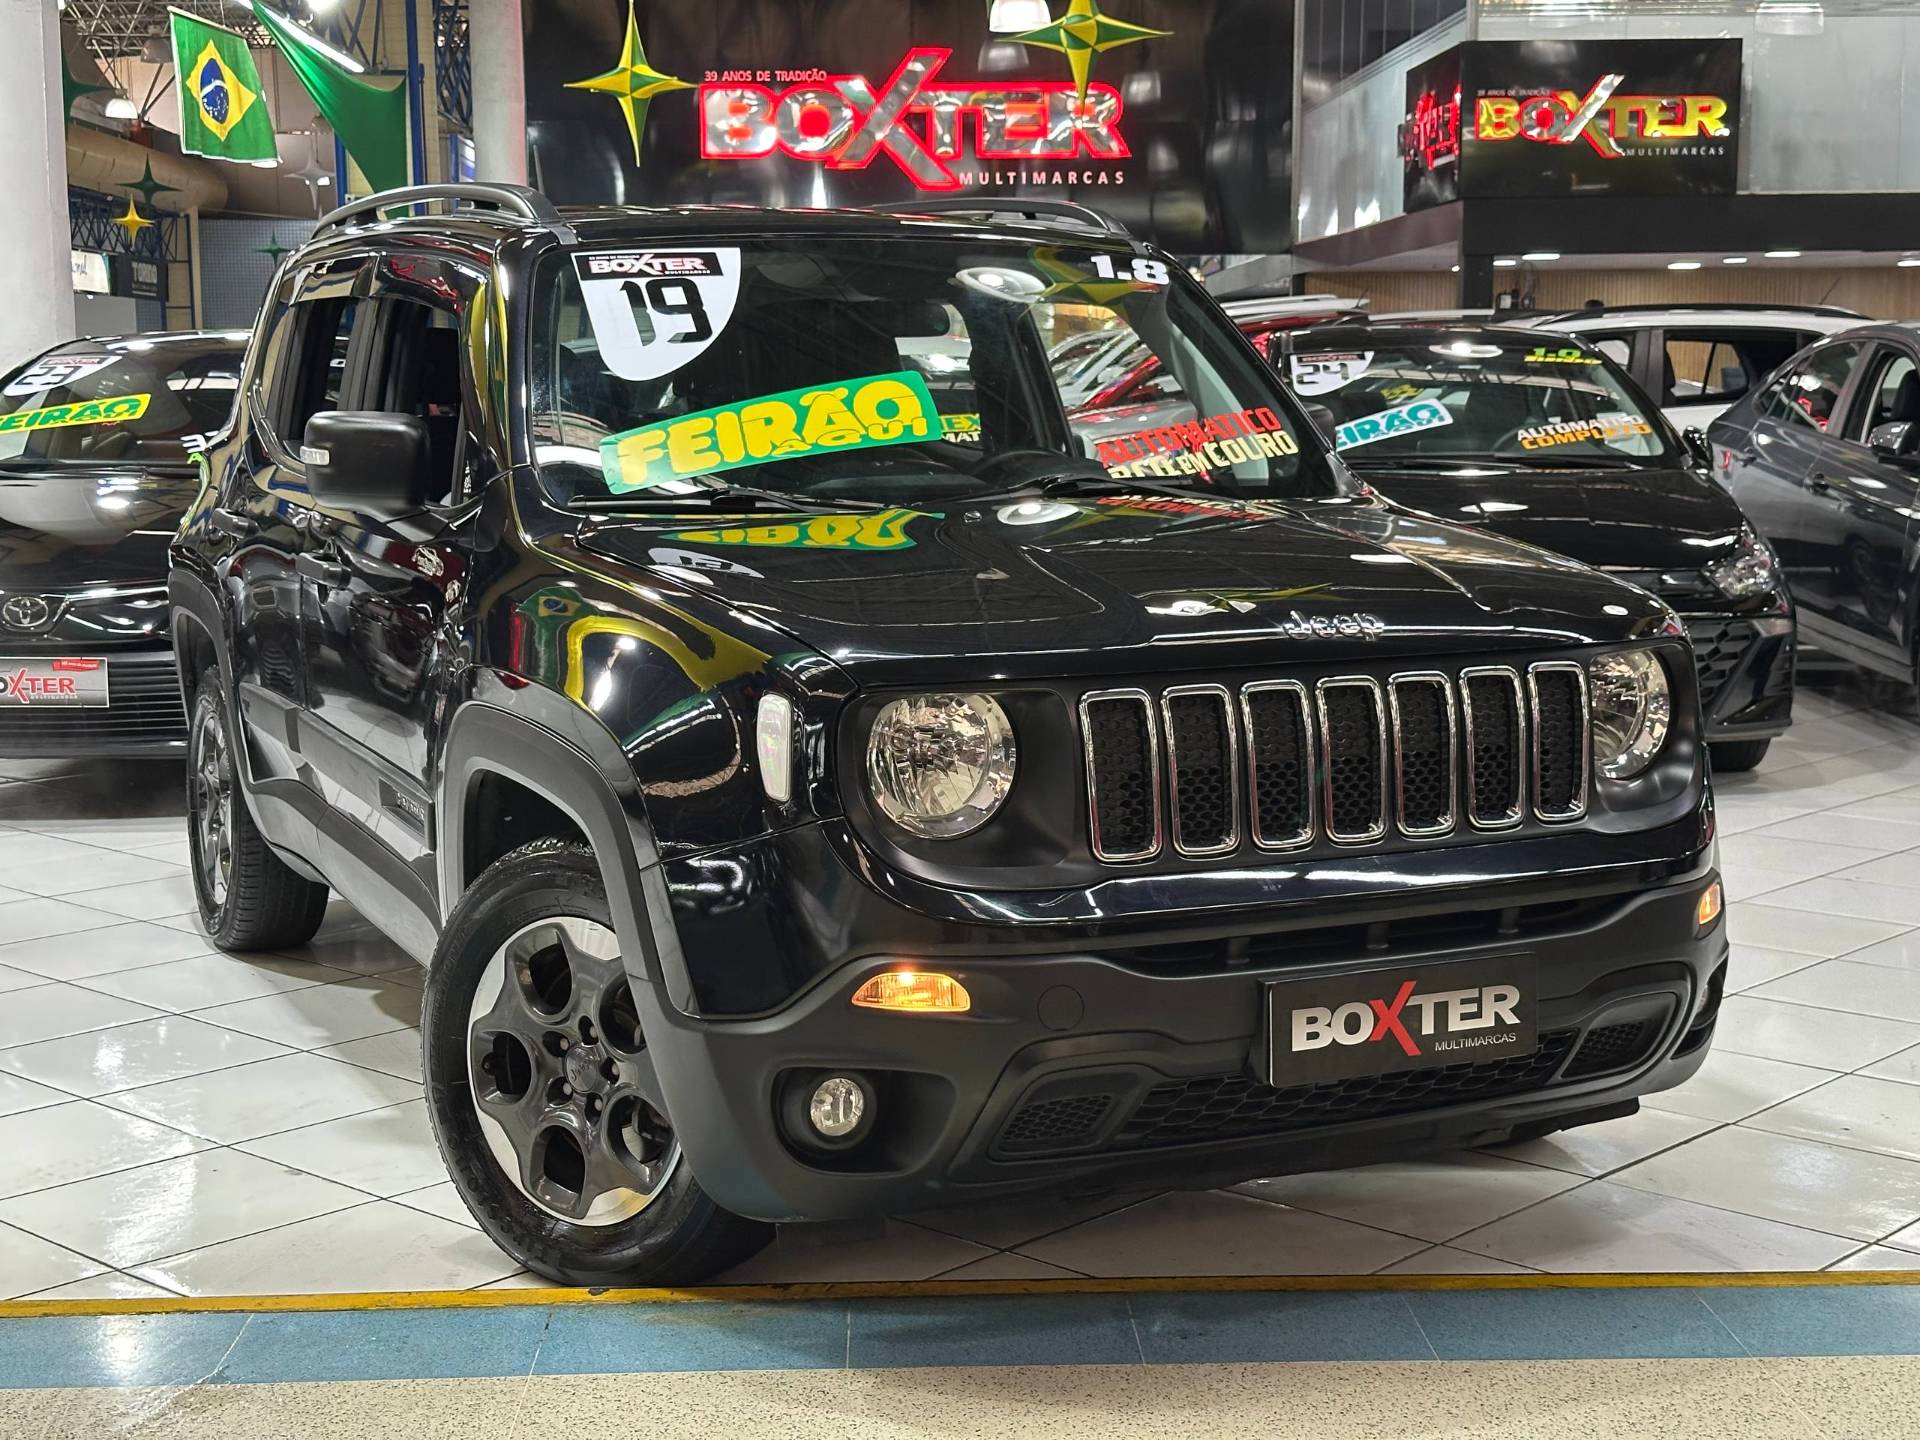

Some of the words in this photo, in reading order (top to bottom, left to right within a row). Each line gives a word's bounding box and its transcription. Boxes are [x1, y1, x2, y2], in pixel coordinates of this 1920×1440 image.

[704, 70, 718, 81] 39
[722, 70, 752, 81] ANOS
[756, 70, 771, 81] DE
[775, 68, 827, 83] TRADIÇÃO
[700, 48, 1132, 191] BOXTER
[1474, 73, 1730, 159] BOXTER
[1626, 146, 1724, 156] MULTIMARCAS
[960, 171, 1124, 185] MULTIMARCAS
[589, 253, 708, 275] BOXTER
[1091, 255, 1169, 285] 1.8
[619, 277, 713, 346] 19
[15, 366, 83, 385] 23
[1296, 362, 1350, 385] 24
[0, 398, 142, 431] EIRÃO
[1336, 403, 1442, 448] EIRÃO
[617, 380, 922, 485] FEIRÃO
[771, 416, 928, 456] AQUI
[1095, 407, 1282, 468] AUTOMATICO
[1203, 430, 1300, 467] COURO
[1521, 424, 1653, 450] COMPLETO
[1283, 609, 1385, 643] Jeep
[0, 667, 77, 704] OXTER
[1292, 980, 1521, 1057] BOXTER
[1435, 1032, 1517, 1052] MULTIMARCAS
